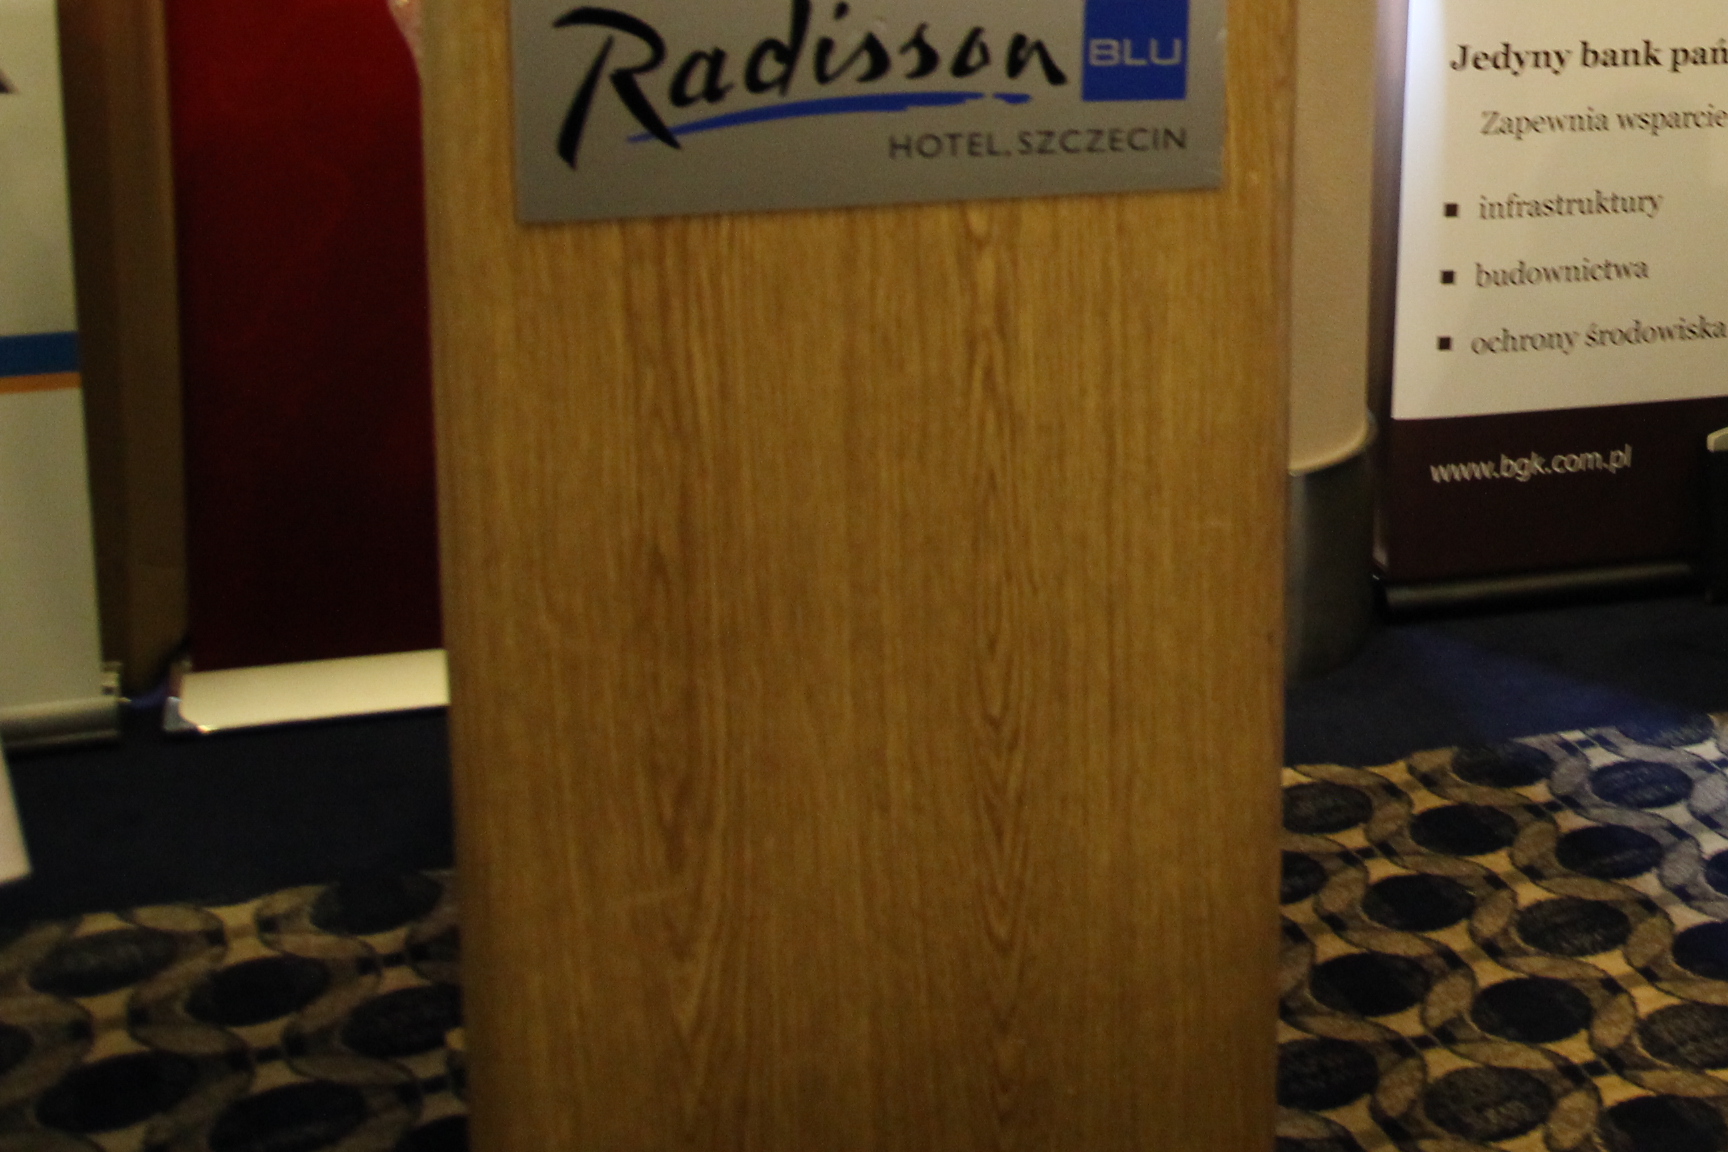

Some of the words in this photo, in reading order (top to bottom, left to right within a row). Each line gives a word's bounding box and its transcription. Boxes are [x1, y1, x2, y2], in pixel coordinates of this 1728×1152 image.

[1089, 38, 1182, 67] BLU
[1450, 43, 1571, 76] Jedyny
[1579, 40, 1663, 69] bank
[1480, 106, 1610, 140] Zapewnia
[1616, 102, 1728, 136] wsparcie
[1017, 127, 1188, 156] SZCZECIN
[1478, 189, 1664, 220] infrastruktury
[1474, 257, 1650, 288] budownictwa
[1470, 327, 1579, 356] ochrony
[1584, 314, 1728, 349] środowiska
[1430, 443, 1633, 484] www.bgk.com.pl
